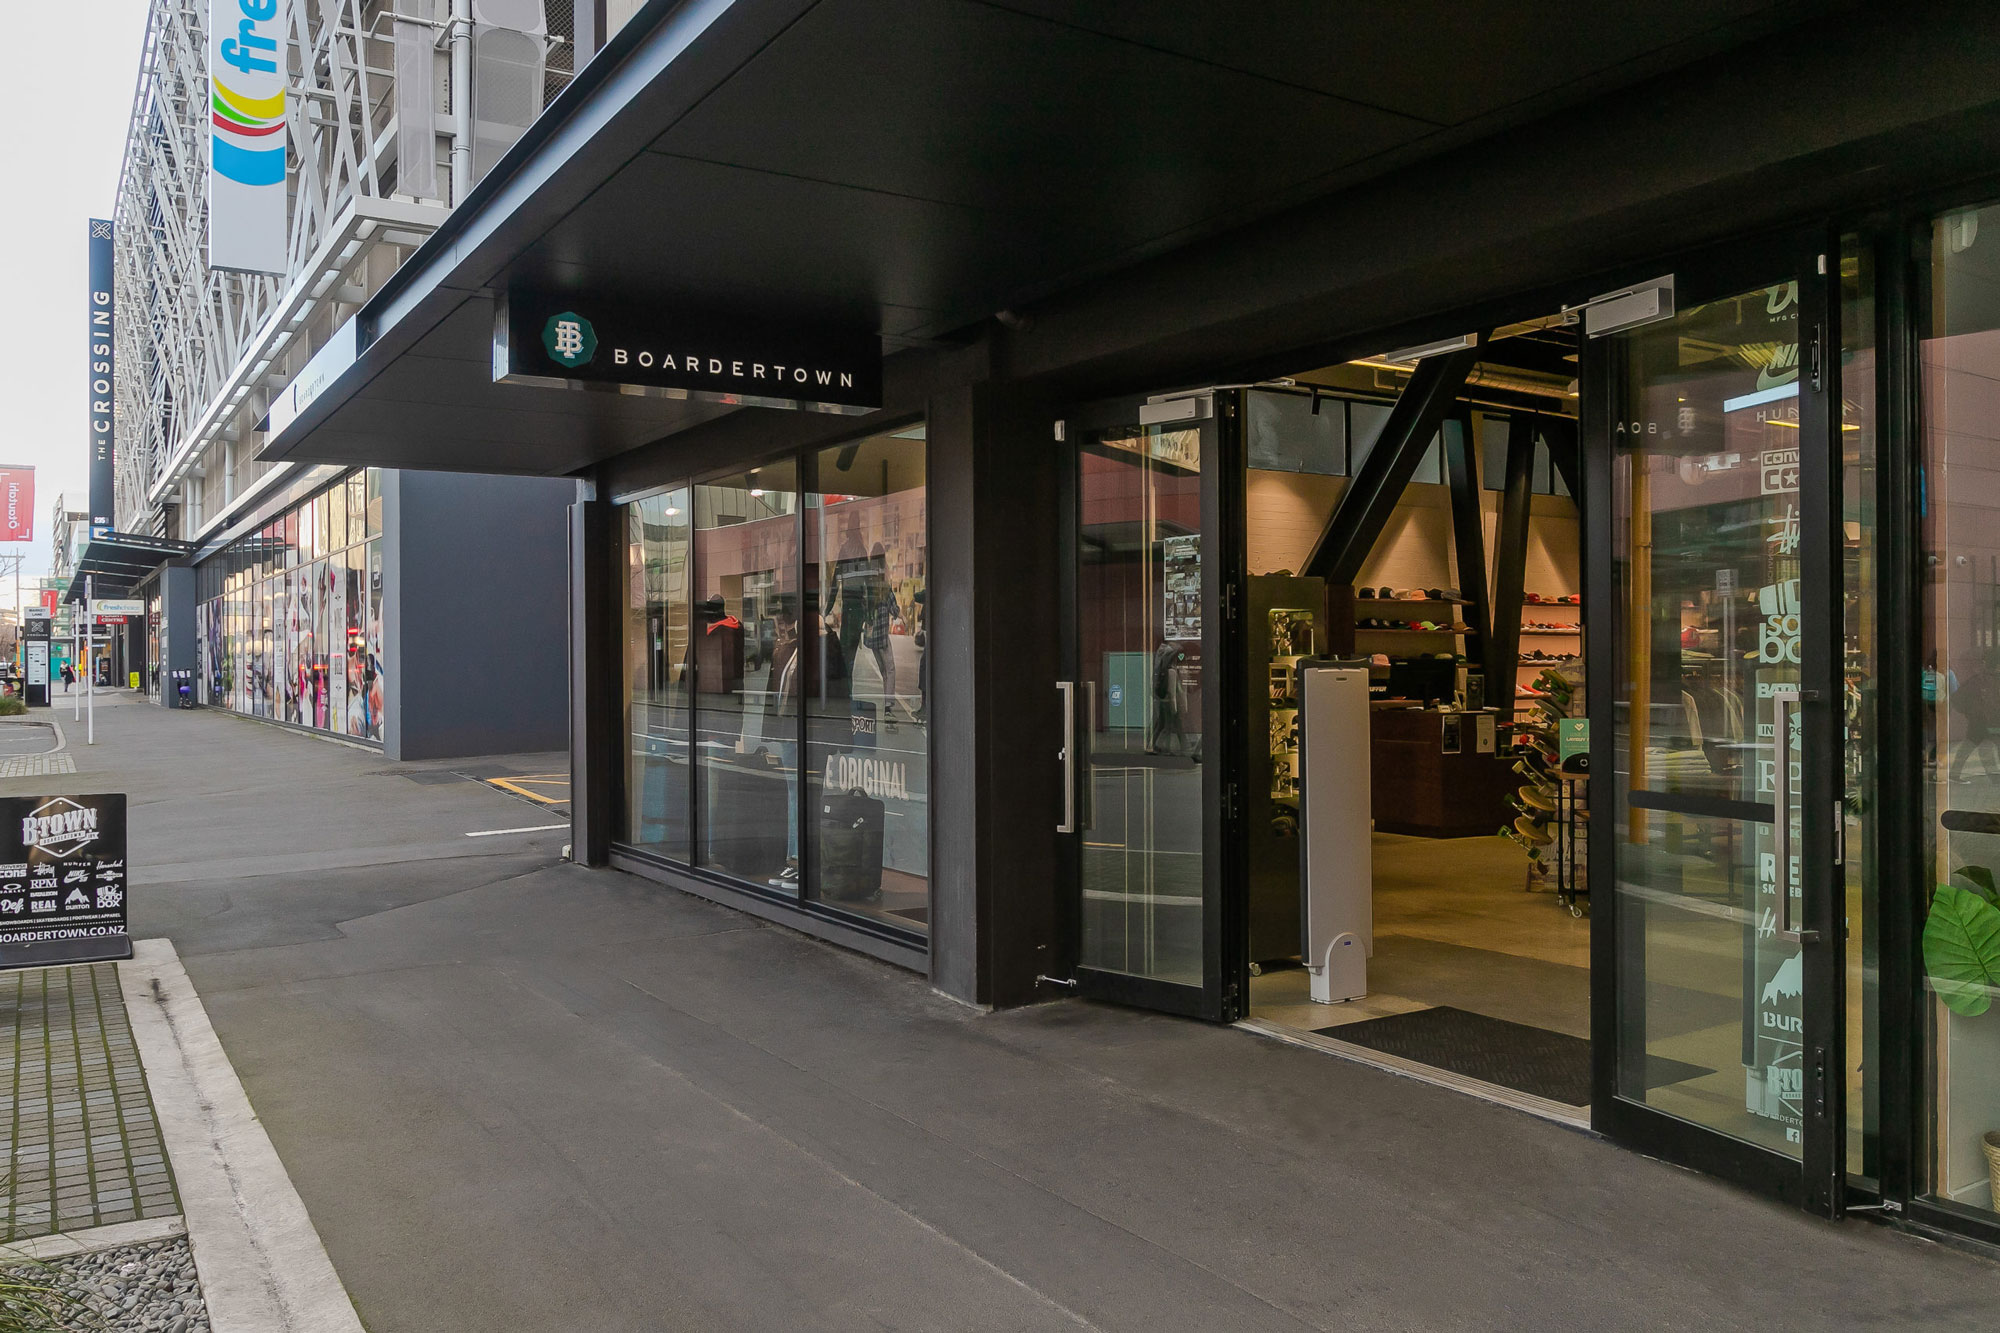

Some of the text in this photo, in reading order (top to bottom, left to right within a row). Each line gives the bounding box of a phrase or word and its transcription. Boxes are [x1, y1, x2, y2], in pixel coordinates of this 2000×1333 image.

[93, 291, 110, 461] THE CROSSING
[614, 348, 853, 389] BOARDERTOWN
[838, 755, 910, 801] ORIGINAL
[30, 879, 58, 889] RPM
[31, 899, 57, 910] REAL
